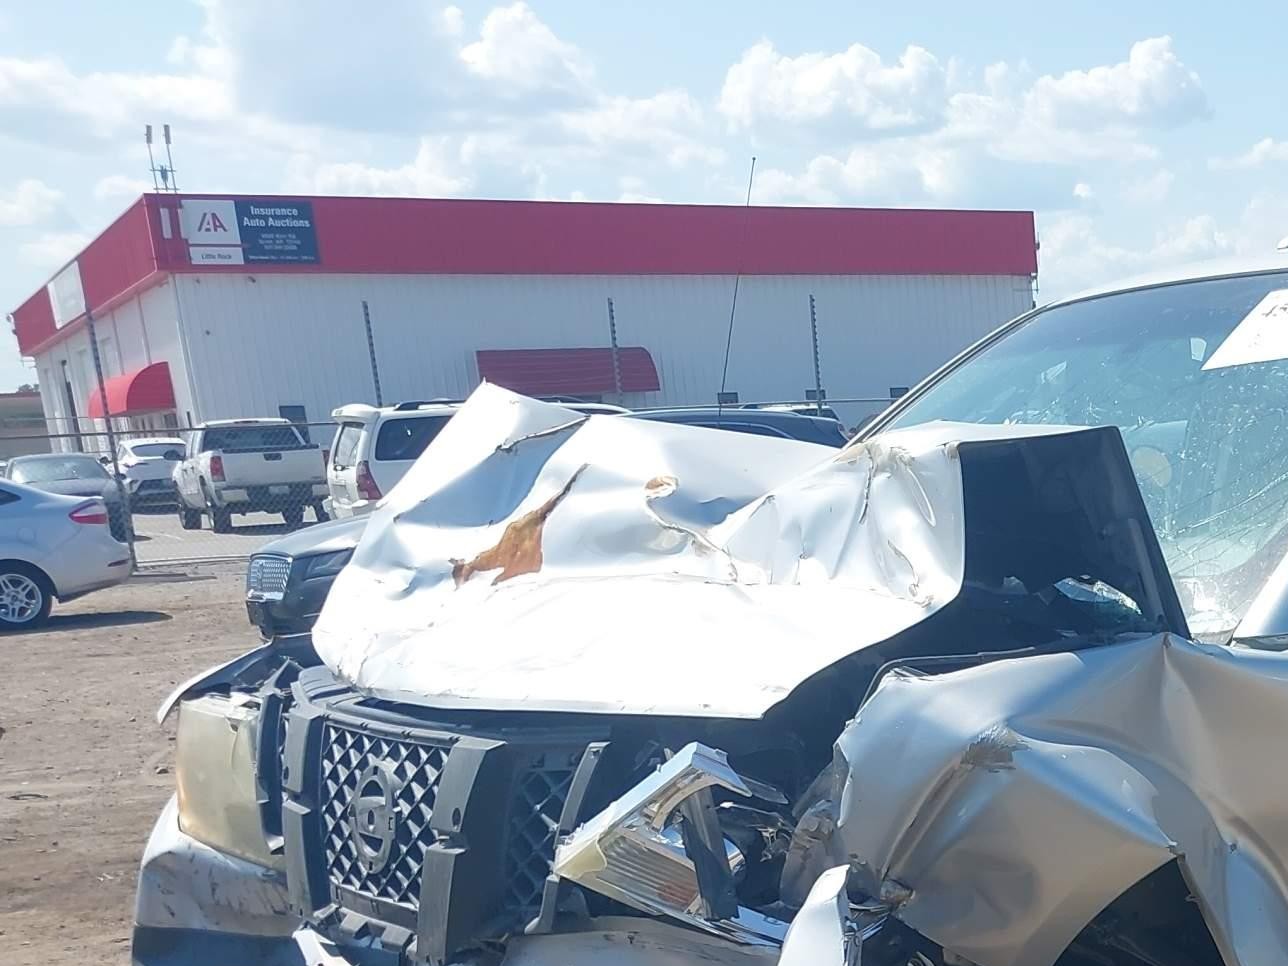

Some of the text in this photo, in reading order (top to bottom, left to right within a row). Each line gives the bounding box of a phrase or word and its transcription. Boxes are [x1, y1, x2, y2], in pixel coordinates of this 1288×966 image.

[250, 206, 298, 216] Insurance
[243, 216, 311, 227] Auto Auctions
